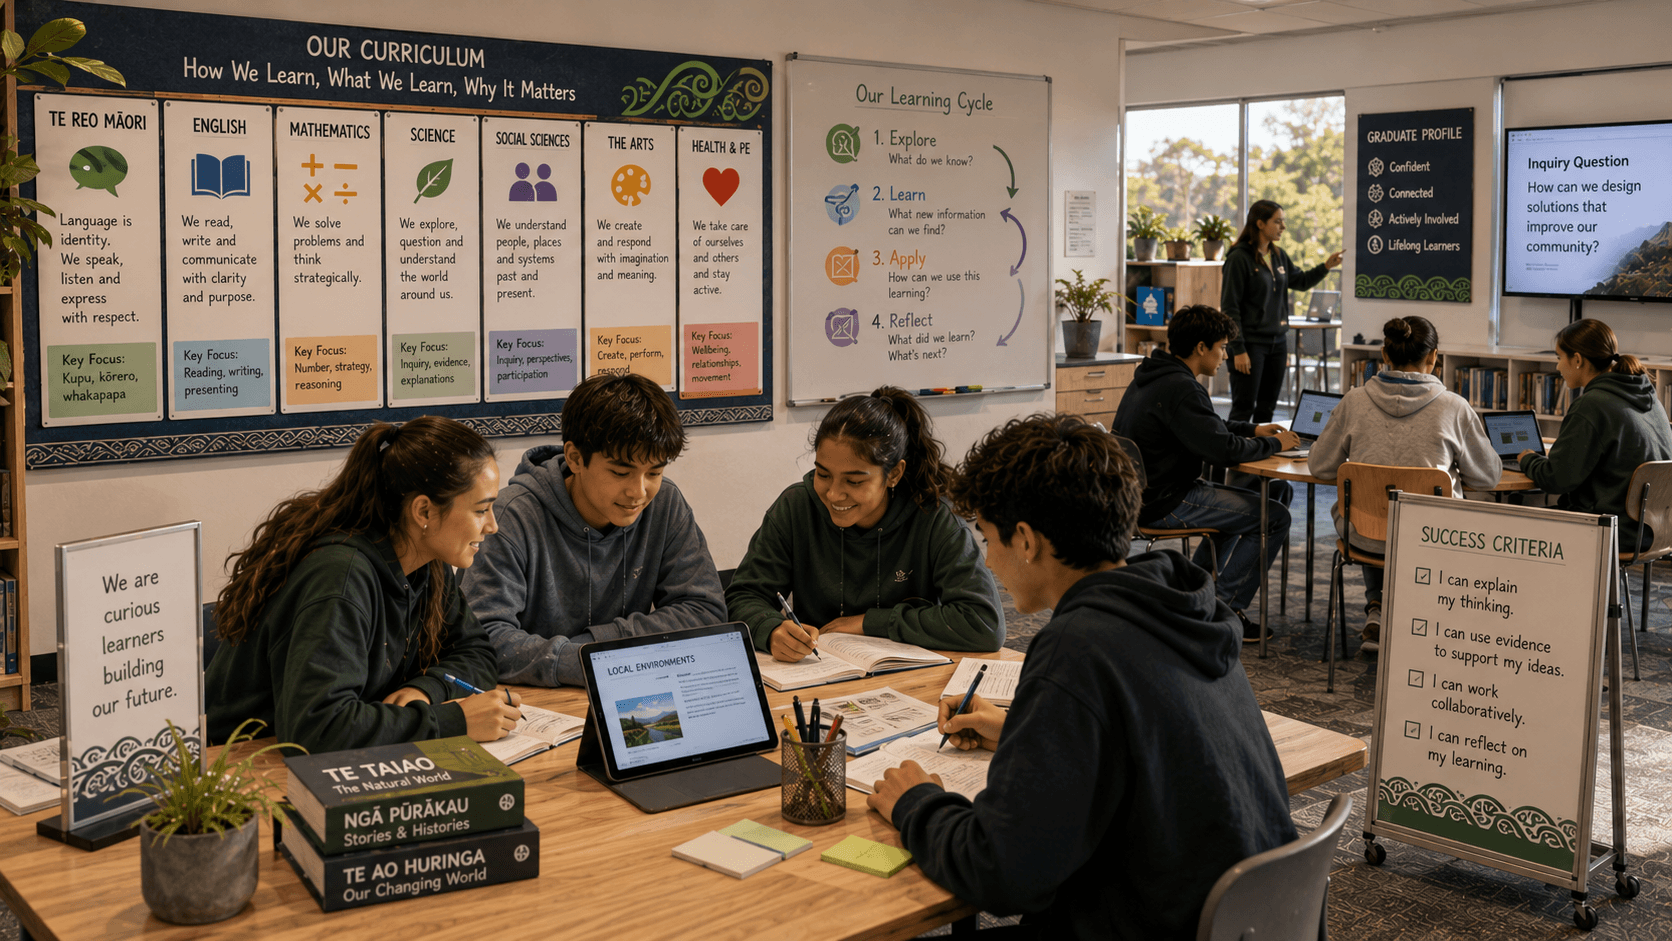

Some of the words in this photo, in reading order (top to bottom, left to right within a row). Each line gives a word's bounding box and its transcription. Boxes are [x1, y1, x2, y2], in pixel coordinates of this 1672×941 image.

[306, 35, 351, 58] OUR
[360, 39, 484, 68] CURRICULUM
[183, 56, 223, 79] How
[231, 59, 258, 81] We
[267, 62, 319, 89] Learn,
[327, 66, 371, 88] What
[378, 70, 402, 90] We
[410, 72, 456, 96] Learn,
[463, 76, 496, 102] Why
[503, 78, 514, 97] It
[521, 79, 575, 101] Matters
[856, 83, 884, 103] Our
[891, 86, 950, 115] Learning
[957, 91, 993, 116] Cycle
[48, 110, 65, 126] TE
[72, 111, 98, 127] REO
[104, 111, 146, 130] MĀORI
[193, 117, 246, 134] ENGLISH
[289, 121, 370, 139] MATHEMATICS
[410, 127, 455, 142] SCIENCE
[1367, 128, 1417, 143] GRADUATE
[1421, 126, 1462, 140] PROFILE
[495, 131, 527, 145] SOCIAL
[529, 132, 570, 147] SCIENCES
[607, 135, 626, 149] THE
[629, 136, 653, 150] ARTS
[692, 139, 725, 153] HEALTH
[729, 141, 736, 153] &
[739, 141, 750, 154] PE
[874, 129, 883, 145] 1.
[890, 129, 936, 151] Explore
[888, 152, 912, 164] What
[915, 153, 927, 165] do
[930, 157, 942, 165] we
[946, 154, 973, 166] know?
[1389, 160, 1430, 172] Confident
[1528, 156, 1570, 171] Inquiry
[1573, 154, 1628, 169] Question
[872, 185, 884, 200] 2.
[890, 185, 925, 201] Learn
[1388, 186, 1433, 198] Connected
[1527, 181, 1554, 193] How
[1556, 183, 1577, 192] can
[1580, 183, 1598, 192] we
[1601, 179, 1641, 195] design
[888, 207, 912, 218] What
[915, 211, 933, 219] new
[937, 207, 985, 219] information
[1526, 200, 1579, 212] solutions
[1582, 199, 1606, 212] that
[292, 215, 309, 228] We
[314, 216, 341, 228] solve
[692, 220, 706, 230] We
[709, 220, 727, 230] take
[1388, 212, 1421, 227] Actively
[1424, 212, 1458, 224] Involved
[1526, 220, 1573, 235] improve
[1576, 223, 1597, 232] our
[923, 223, 945, 234] find?
[293, 234, 340, 250] problems
[345, 234, 364, 246] and
[692, 235, 701, 246] of
[705, 235, 743, 246] ourselves
[1388, 238, 1421, 254] Lifelong
[1423, 239, 1460, 251] Learners
[1526, 239, 1599, 255] community?
[293, 252, 321, 264] think
[692, 251, 708, 262] and
[712, 251, 739, 262] others
[872, 249, 884, 265] 3.
[889, 249, 926, 270] Apply
[293, 270, 361, 287] strategically.
[693, 267, 709, 278] and
[712, 269, 730, 281] stay
[888, 271, 908, 282] How
[911, 274, 927, 282] can
[946, 273, 961, 281] use
[964, 269, 980, 280] this
[693, 284, 721, 294] active.
[888, 286, 930, 301] learning?
[871, 313, 884, 329] 4.
[889, 312, 932, 328] Reflect
[887, 333, 911, 345] What
[915, 332, 929, 343] did
[948, 329, 975, 342] learn?
[597, 350, 626, 360] Create,
[629, 348, 663, 361] perform,
[887, 348, 918, 361] What's
[922, 346, 947, 359] next?
[294, 361, 332, 373] Number,
[62, 372, 94, 387] Kupu,
[99, 370, 138, 382] kōrero,
[295, 378, 341, 391] reasoning
[400, 373, 454, 387] explanations
[691, 373, 730, 382] movement
[63, 389, 126, 404] whakapapa
[184, 383, 238, 399] presenting
[1421, 525, 1485, 549] SUCCESS
[1492, 535, 1563, 559] CRITERIA
[102, 573, 127, 593] We
[134, 572, 158, 588] are
[1439, 569, 1442, 584] I
[1447, 575, 1468, 587] can
[1473, 576, 1517, 595] explain
[103, 601, 160, 623] curious
[1437, 595, 1455, 610] my
[1459, 594, 1513, 619] thinking.
[102, 629, 164, 654] learners
[1435, 621, 1439, 635] I
[1443, 628, 1464, 639] can
[1470, 632, 1490, 644] use
[1495, 634, 1550, 653] evidence
[607, 664, 633, 675] LOCAL
[635, 654, 695, 671] ENVIRONMENTS
[1434, 643, 1446, 657] to
[1451, 649, 1498, 667] support
[1503, 658, 1522, 674] my
[1528, 658, 1563, 676] ideas.
[103, 657, 163, 684] building
[92, 699, 119, 717] our
[125, 685, 176, 708] future.
[1431, 696, 1524, 728] collaboratively.
[1429, 725, 1432, 739] I
[1437, 732, 1459, 744] can
[1464, 734, 1506, 753] reflect
[1511, 746, 1526, 757] on
[321, 766, 359, 782] TE
[359, 757, 435, 777] TAIAO
[1428, 750, 1446, 767] my
[1452, 750, 1506, 779] learning.
[332, 781, 360, 794] The
[361, 777, 411, 791] Natural
[412, 770, 452, 784] World
[344, 805, 383, 828] NGĀ
[344, 829, 391, 846] Stories
[396, 825, 406, 839] &
[412, 818, 469, 836] Histories
[342, 865, 365, 884] TE
[371, 861, 398, 880] AO
[404, 848, 486, 875] HURINGA
[342, 883, 370, 902] Our
[375, 876, 441, 896] Changing
[445, 866, 486, 885] World
